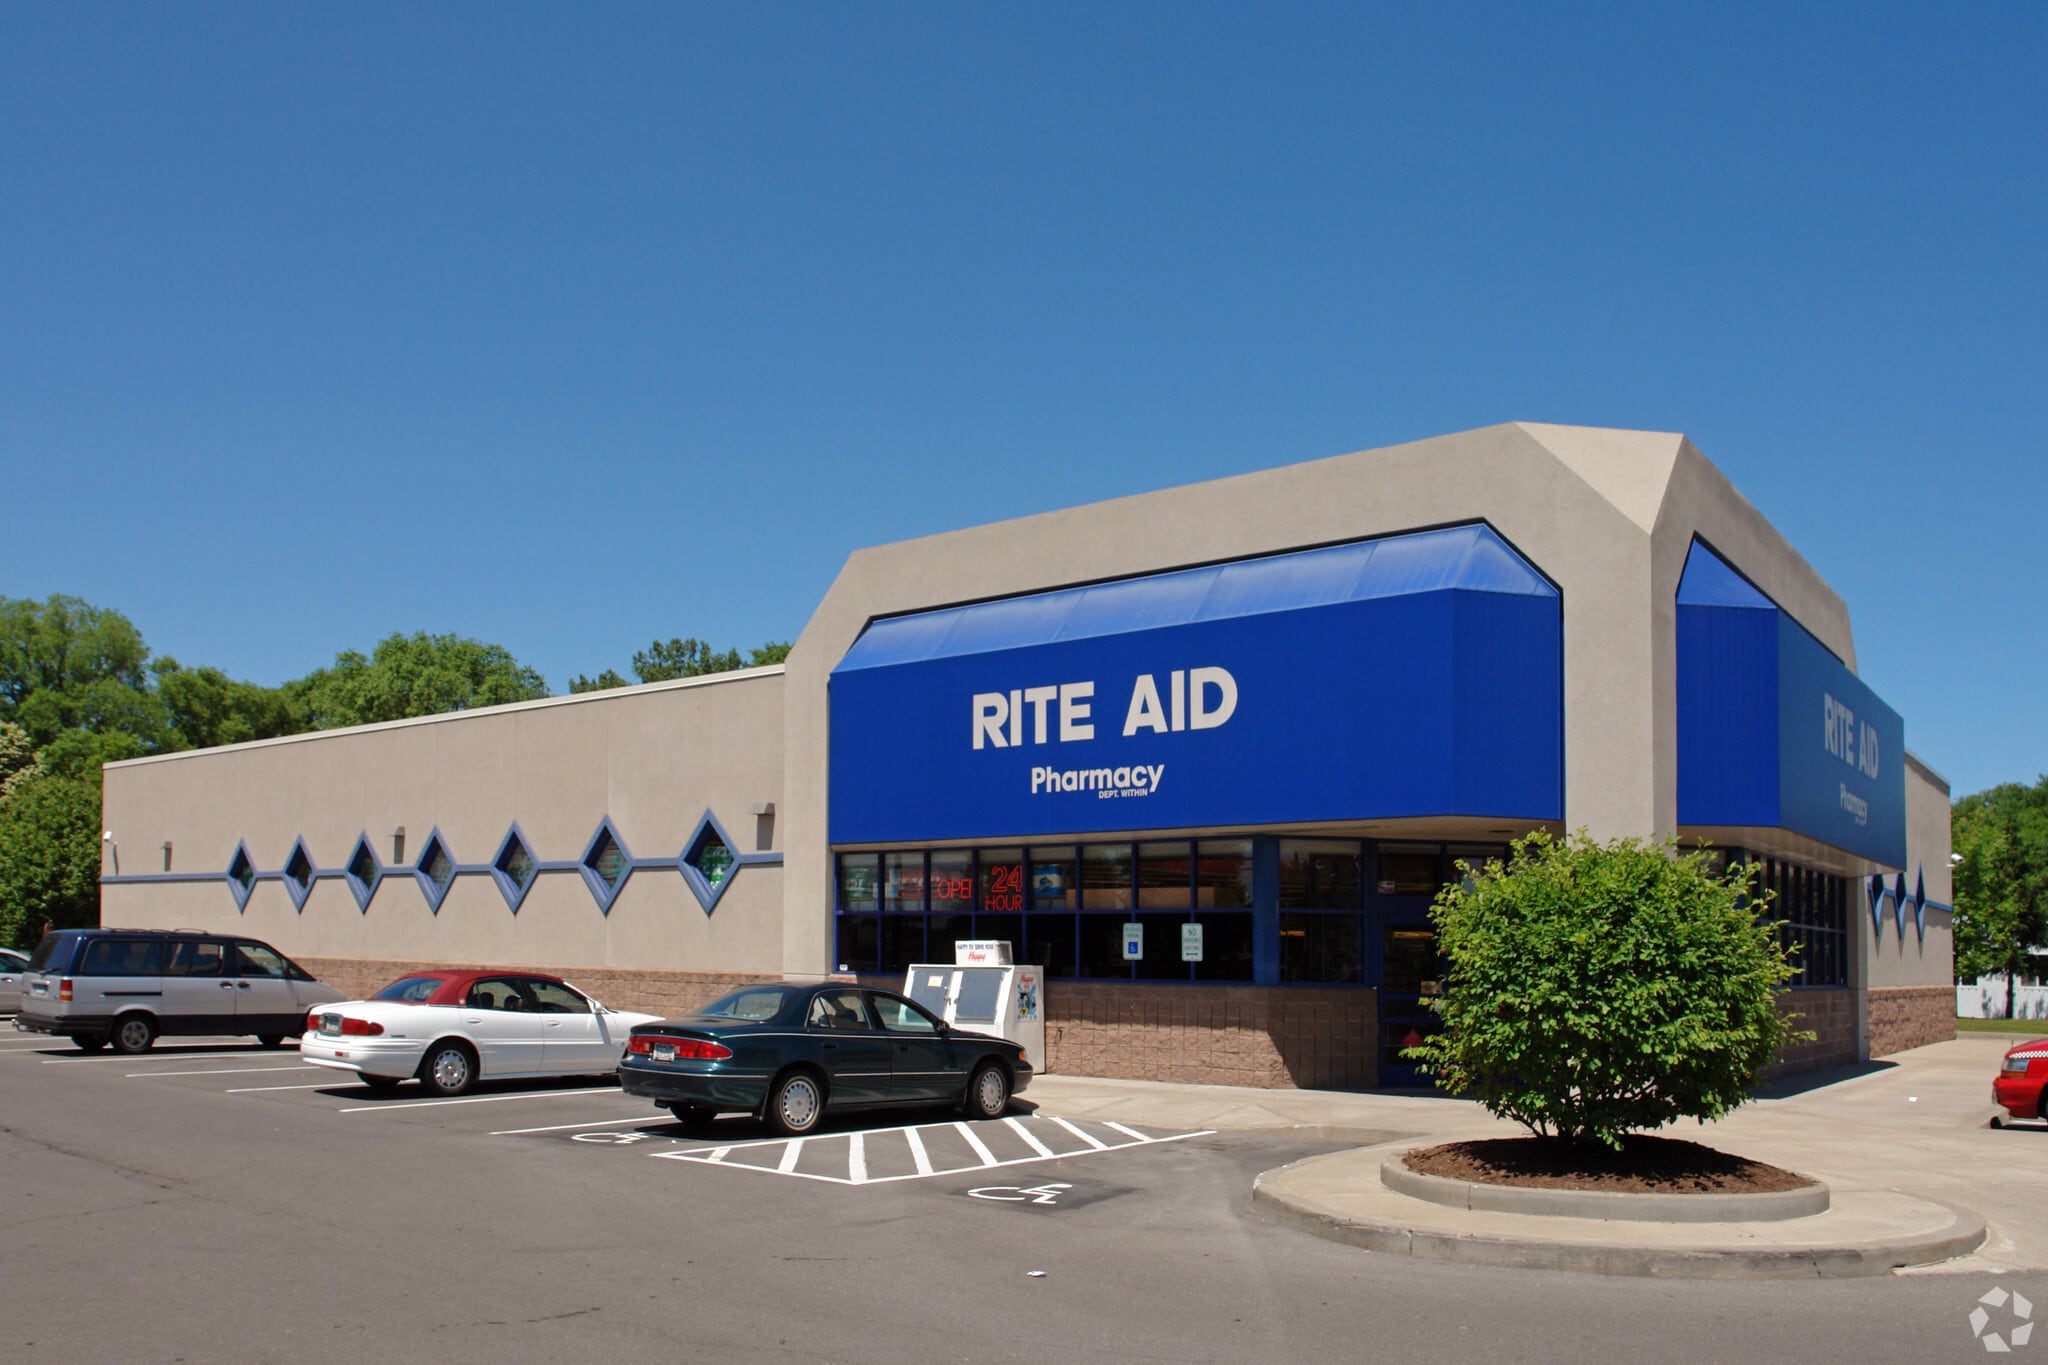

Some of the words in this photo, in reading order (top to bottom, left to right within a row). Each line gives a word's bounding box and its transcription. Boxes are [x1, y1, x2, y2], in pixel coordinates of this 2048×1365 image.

[973, 681, 1095, 750] RITE
[1122, 666, 1238, 737] AID
[1824, 692, 1854, 767] RITE
[1859, 719, 1879, 779] AID
[1031, 764, 1165, 794] Pharmacy
[1098, 790, 1119, 799] DEPT.
[1121, 788, 1148, 798] WITHIN
[937, 878, 972, 899] OPE
[991, 865, 1022, 893] 24
